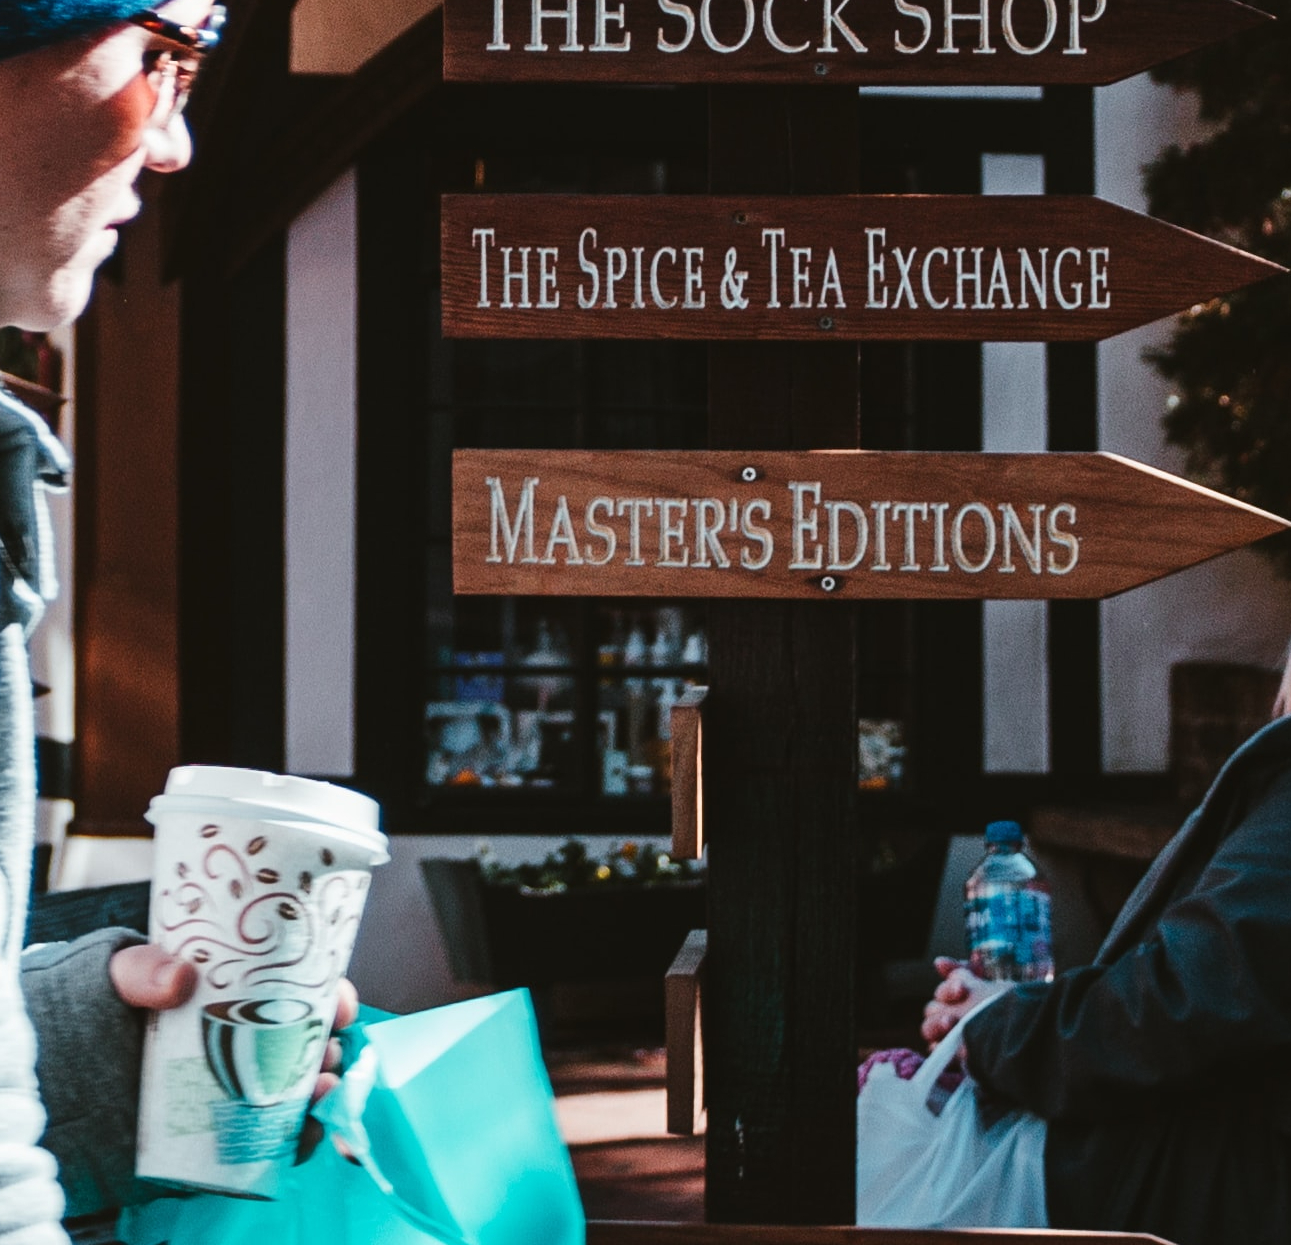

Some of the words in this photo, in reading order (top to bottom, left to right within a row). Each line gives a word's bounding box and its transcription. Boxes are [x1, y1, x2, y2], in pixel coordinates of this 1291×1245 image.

[471, 227, 560, 309] THE
[576, 227, 706, 310] SPICE
[718, 245, 750, 310] &
[760, 227, 847, 309] TEA
[863, 227, 1112, 311] EXCHANGE
[483, 475, 774, 571] MASTER'S
[787, 481, 1082, 577] EDITIONS
